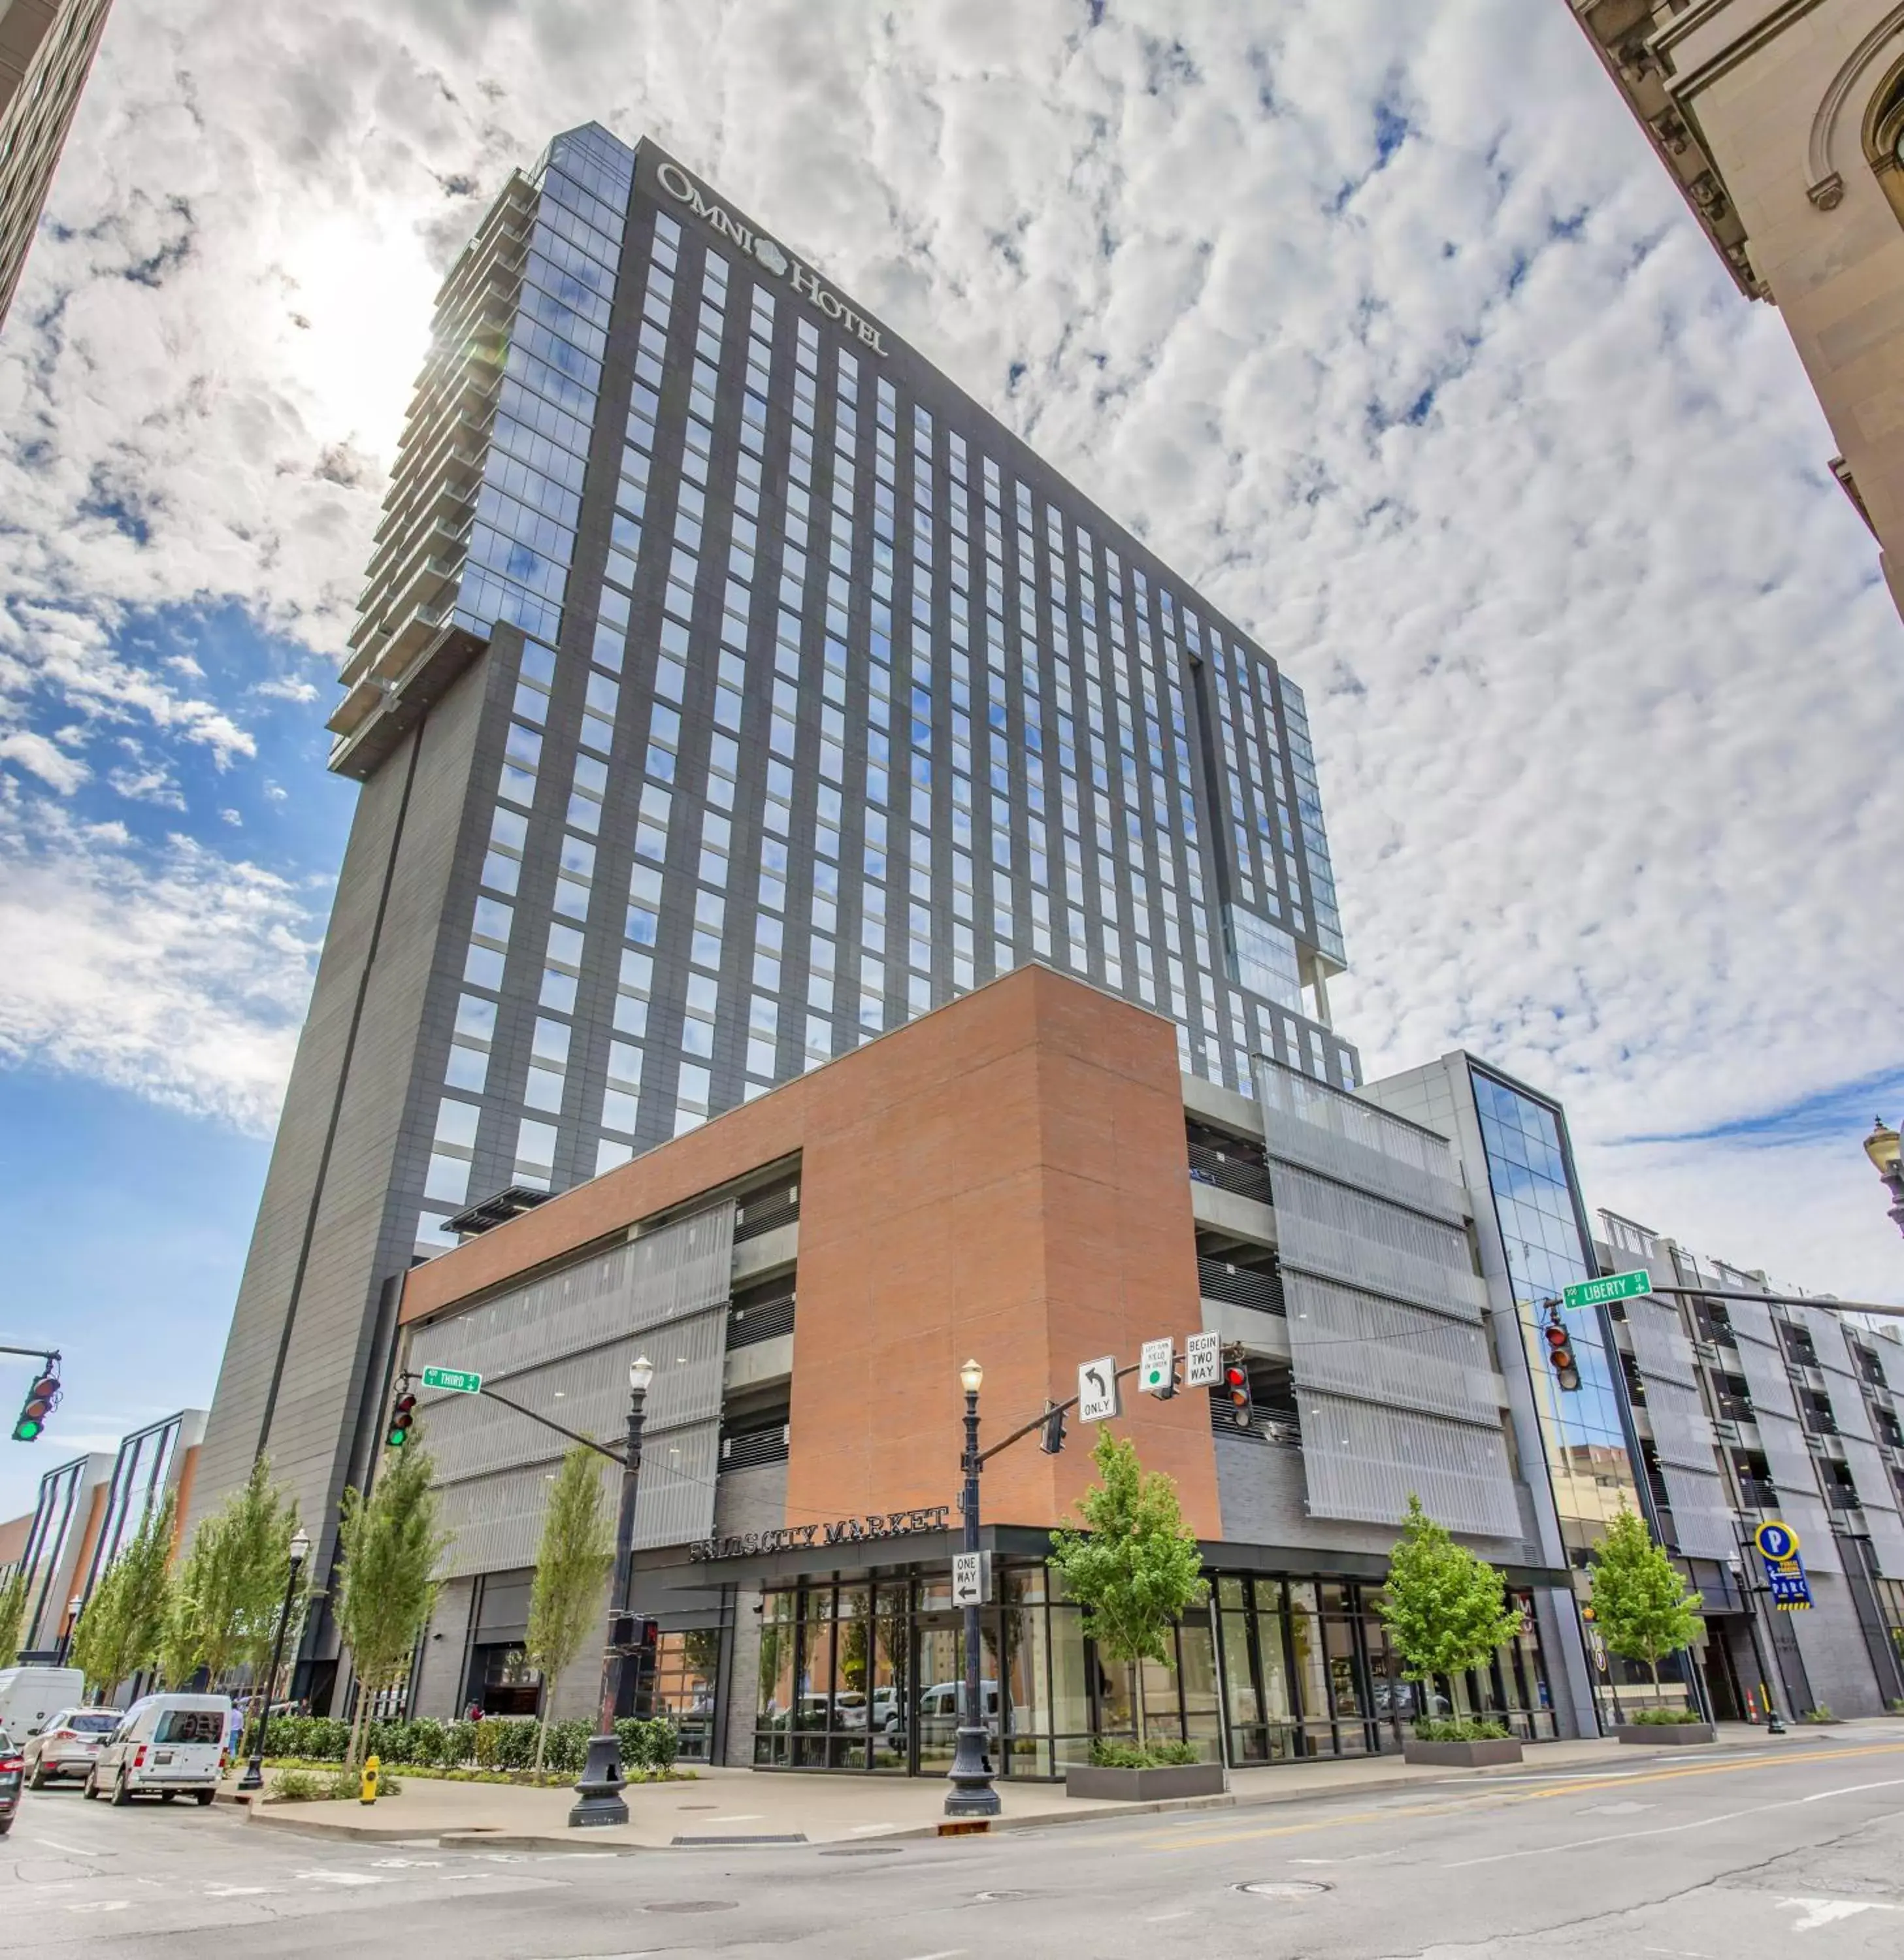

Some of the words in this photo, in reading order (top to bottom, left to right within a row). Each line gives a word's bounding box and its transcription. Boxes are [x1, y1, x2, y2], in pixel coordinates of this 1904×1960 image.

[657, 163, 753, 255] OMNI
[790, 259, 889, 357] HOTEL
[1584, 1279, 1626, 1301] LIBERTY
[1189, 1336, 1216, 1352] BEGIN
[1192, 1352, 1212, 1364] TWO
[441, 1372, 465, 1388] THIRD
[1191, 1365, 1214, 1380] WAY
[1085, 1399, 1110, 1416] ONLY
[763, 1524, 818, 1554] CITY
[823, 1506, 949, 1545] MARKET
[1767, 1529, 1781, 1553] P
[957, 1557, 976, 1569] ONE
[957, 1570, 976, 1582] WAY
[1771, 1581, 1806, 1594] PARC
